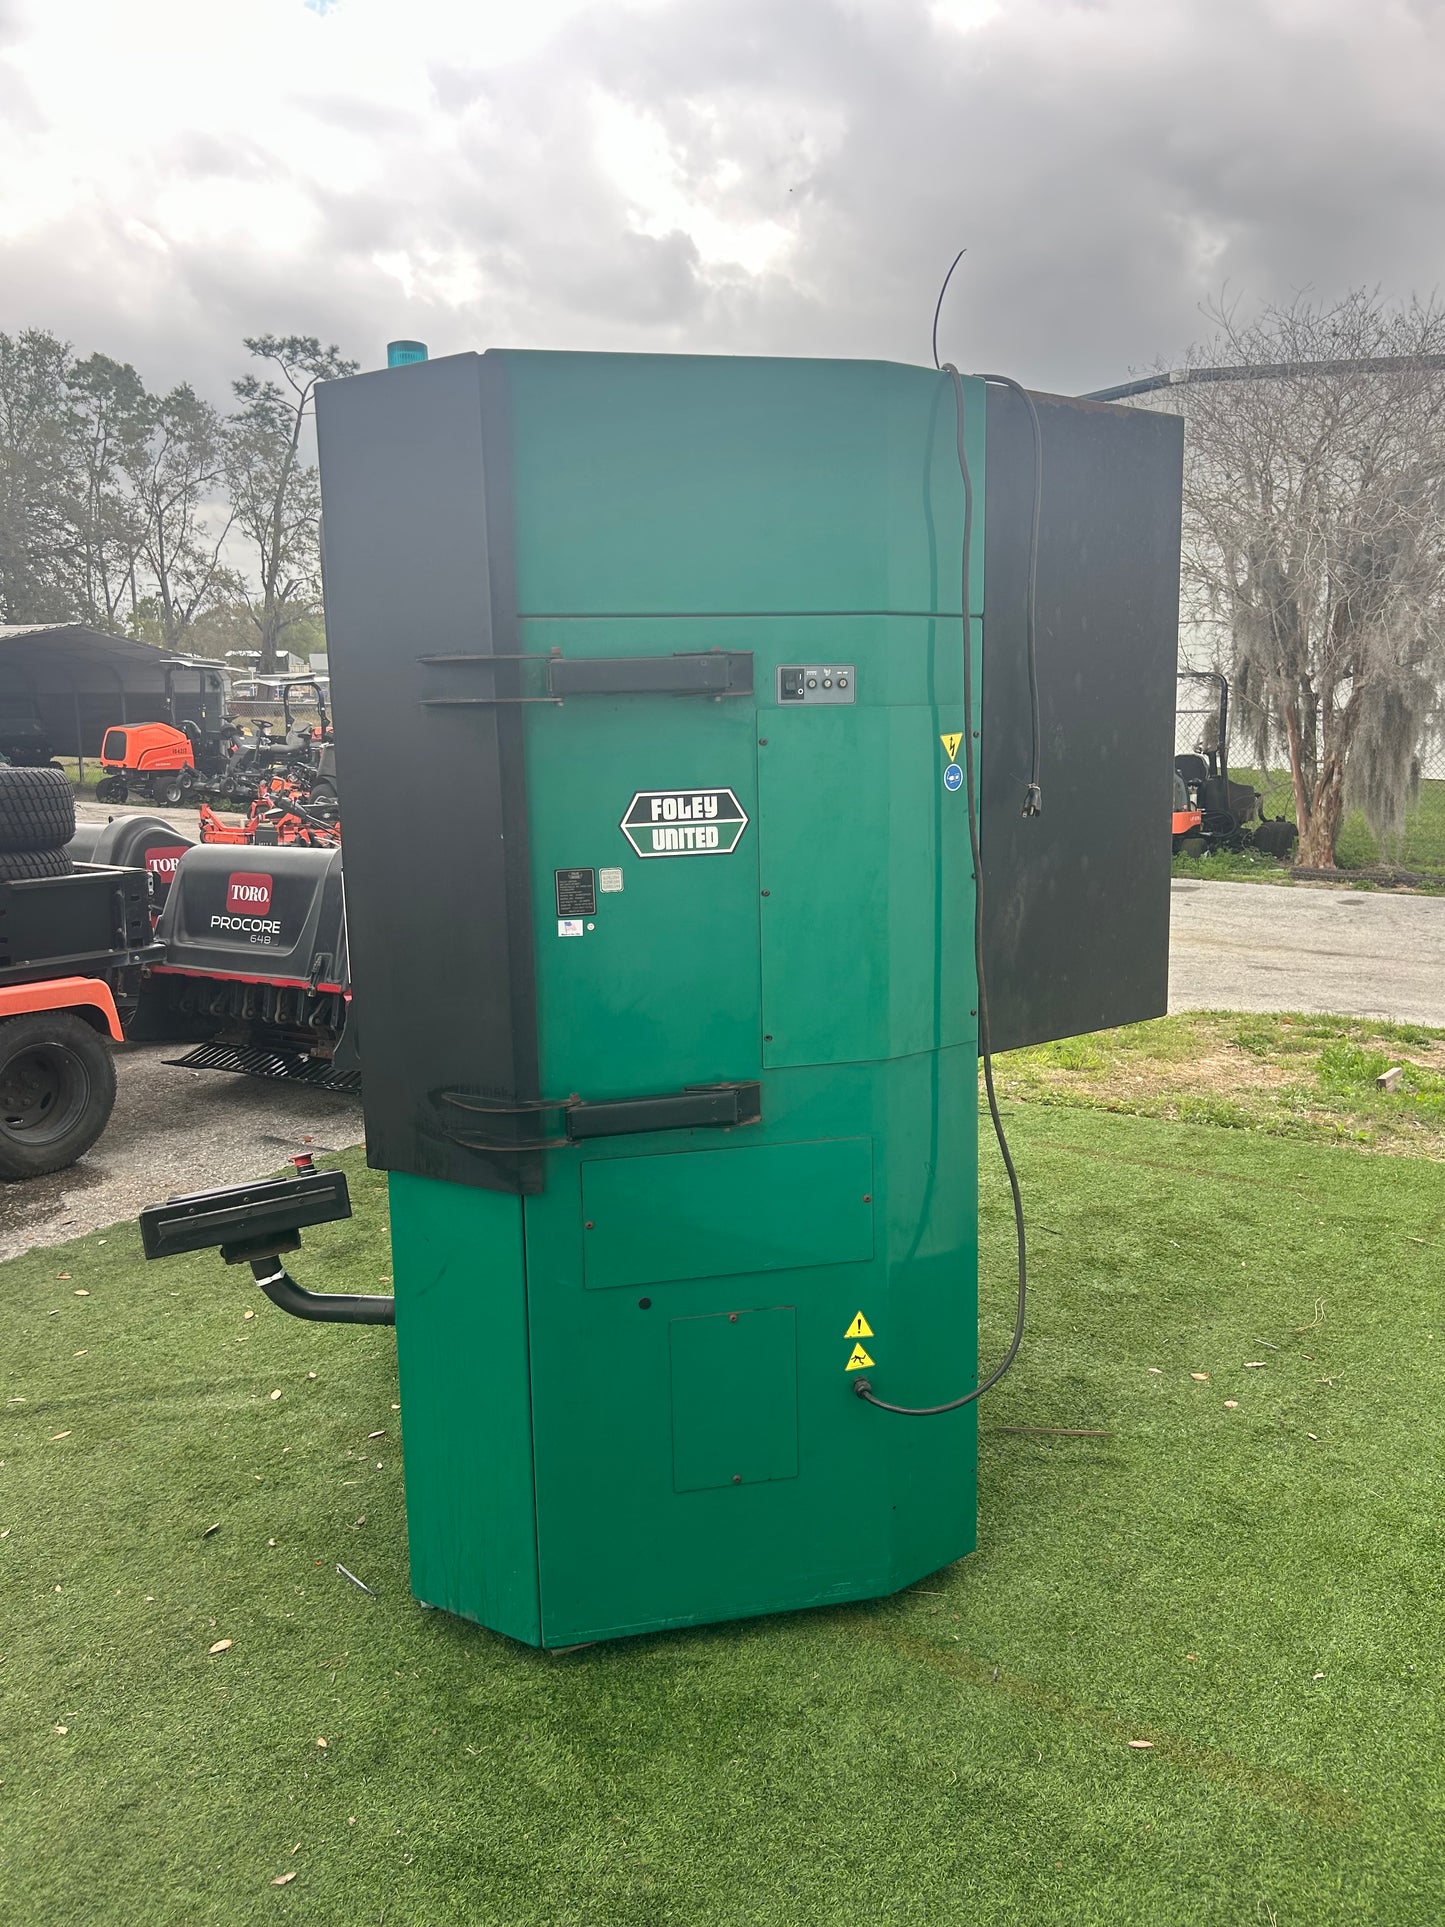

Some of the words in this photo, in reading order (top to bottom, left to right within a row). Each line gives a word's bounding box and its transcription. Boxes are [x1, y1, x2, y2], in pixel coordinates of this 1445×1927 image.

[651, 796, 718, 821] FOLEY
[652, 826, 719, 850] UNITED
[149, 858, 180, 873] TOR
[210, 915, 281, 934] PROCORE
[250, 934, 271, 945] 648
